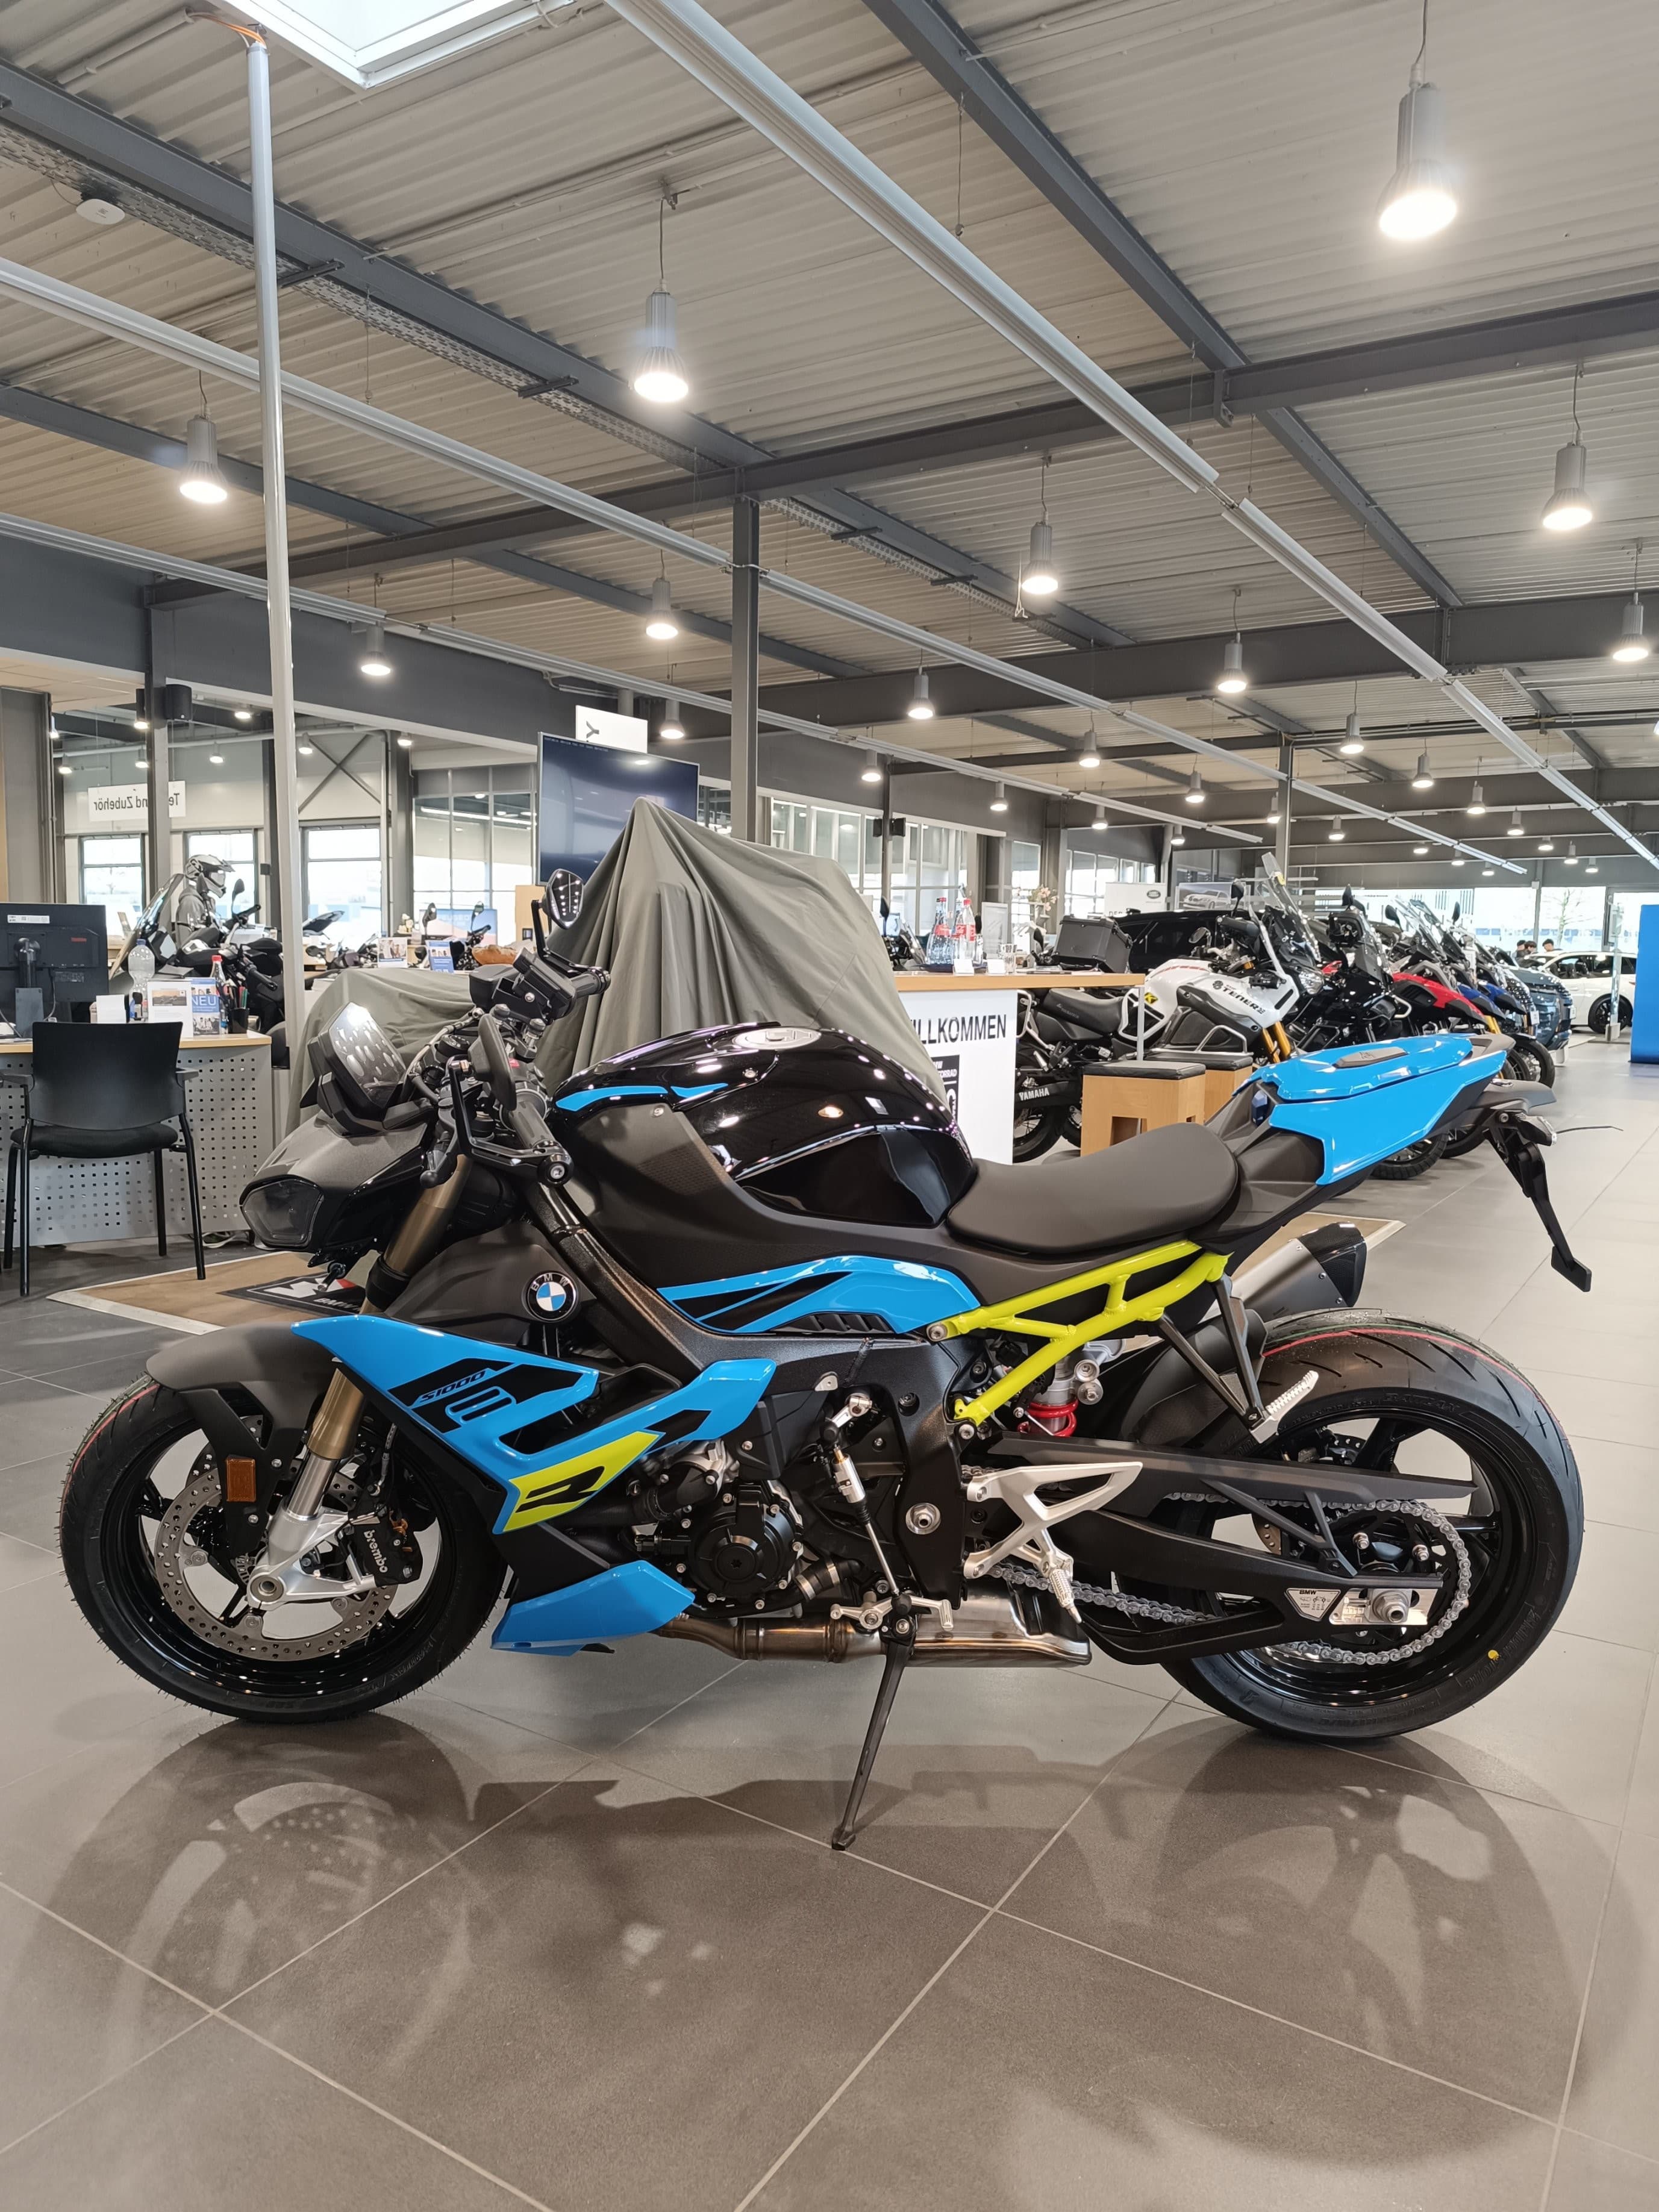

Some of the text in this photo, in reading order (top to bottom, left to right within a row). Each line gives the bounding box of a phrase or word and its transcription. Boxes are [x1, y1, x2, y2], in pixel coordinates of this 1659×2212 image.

[192, 996, 216, 1006] NEU
[911, 1014, 1007, 1045] ILLKOMMEN
[1019, 1088, 1049, 1101] YAMAHA
[531, 1273, 570, 1292] BMW
[420, 1370, 486, 1403] S1000
[515, 1466, 605, 1513] R
[363, 1529, 388, 1573] brembo
